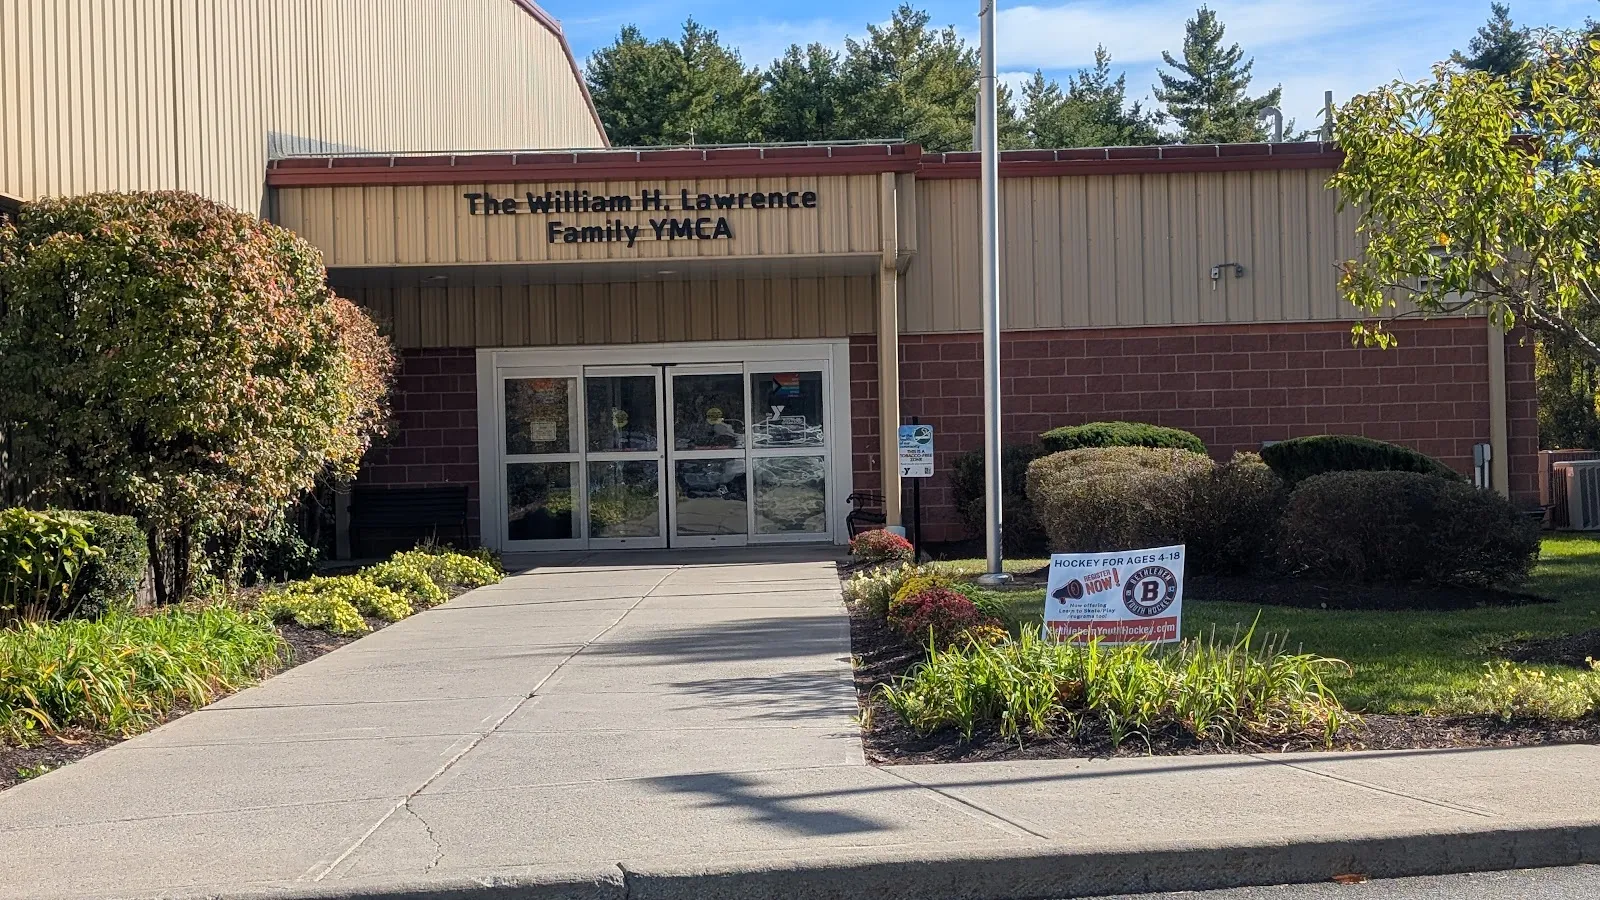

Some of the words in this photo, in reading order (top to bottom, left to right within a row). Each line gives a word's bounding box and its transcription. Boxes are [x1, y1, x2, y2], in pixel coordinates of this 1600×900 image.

[464, 192, 517, 215] The
[526, 189, 631, 214] William
[642, 189, 670, 212] H.
[681, 189, 817, 211] Lawrence
[548, 219, 639, 248] Family
[649, 217, 732, 241] YMCA
[1054, 559, 1100, 568] HOCKEY
[1102, 557, 1123, 567] FOR
[1126, 556, 1156, 565] AGES
[1158, 551, 1181, 561] 4-18
[1083, 569, 1112, 582] REGISTER
[1130, 568, 1171, 584] BETHLEHEM
[1141, 581, 1159, 602] B
[1127, 599, 1145, 615] YOUTH
[1147, 596, 1172, 615] HOCKEY
